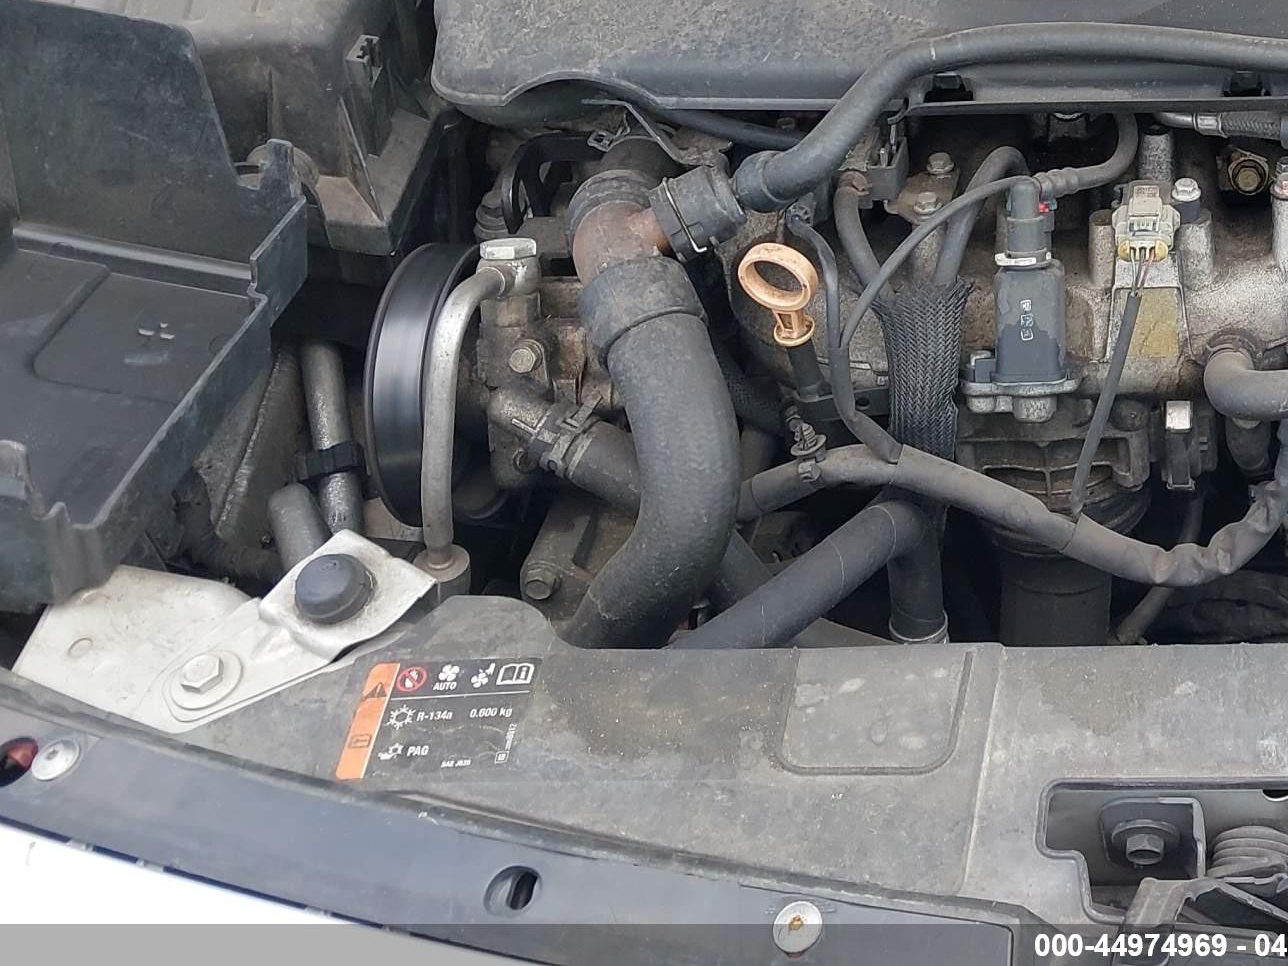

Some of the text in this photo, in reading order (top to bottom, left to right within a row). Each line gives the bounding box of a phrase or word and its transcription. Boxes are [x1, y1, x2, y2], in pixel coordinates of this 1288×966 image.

[432, 681, 457, 691] AUTO
[416, 707, 513, 721] R-134a 0.600 kg
[406, 745, 429, 757] PAG
